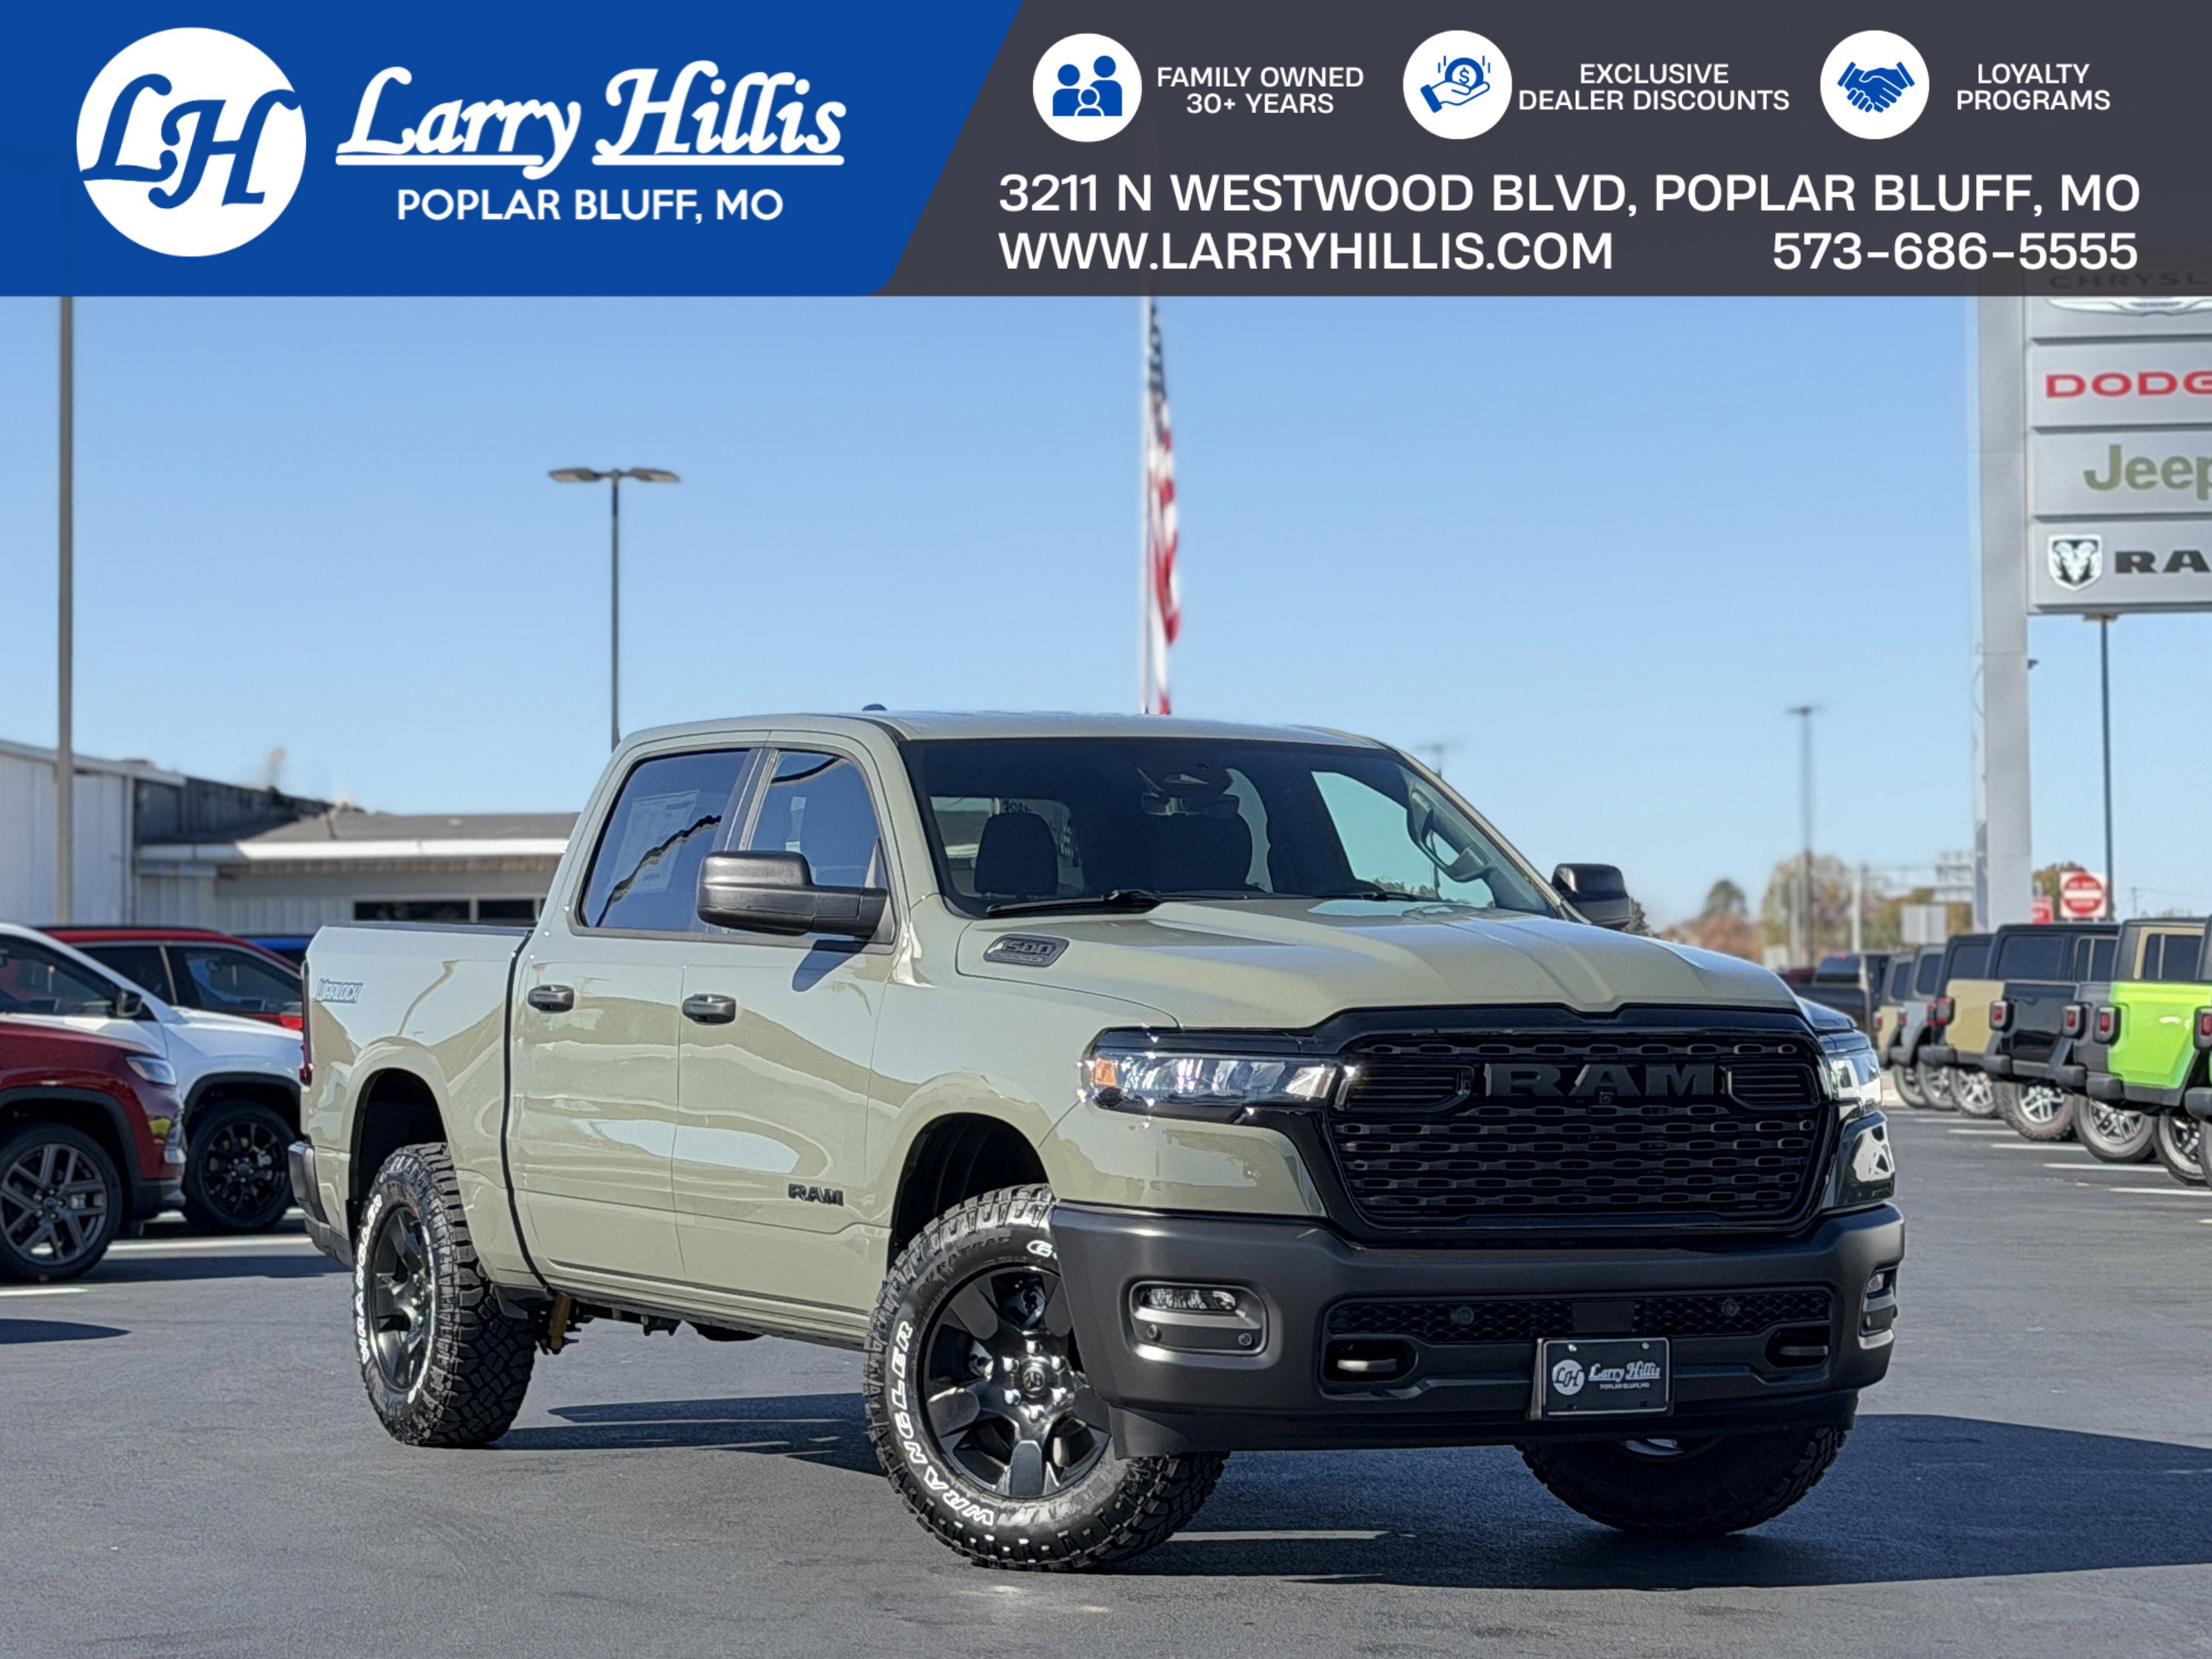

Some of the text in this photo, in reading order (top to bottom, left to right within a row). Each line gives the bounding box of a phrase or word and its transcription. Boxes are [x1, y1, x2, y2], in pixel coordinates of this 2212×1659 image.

[2046, 371, 2212, 398] DODG
[2115, 550, 2211, 574] RA
[1484, 1063, 1715, 1097] RAM
[788, 1183, 844, 1207] RAM
[1625, 1360, 1661, 1380] Hillis
[891, 1321, 995, 1526] WRANGLER
